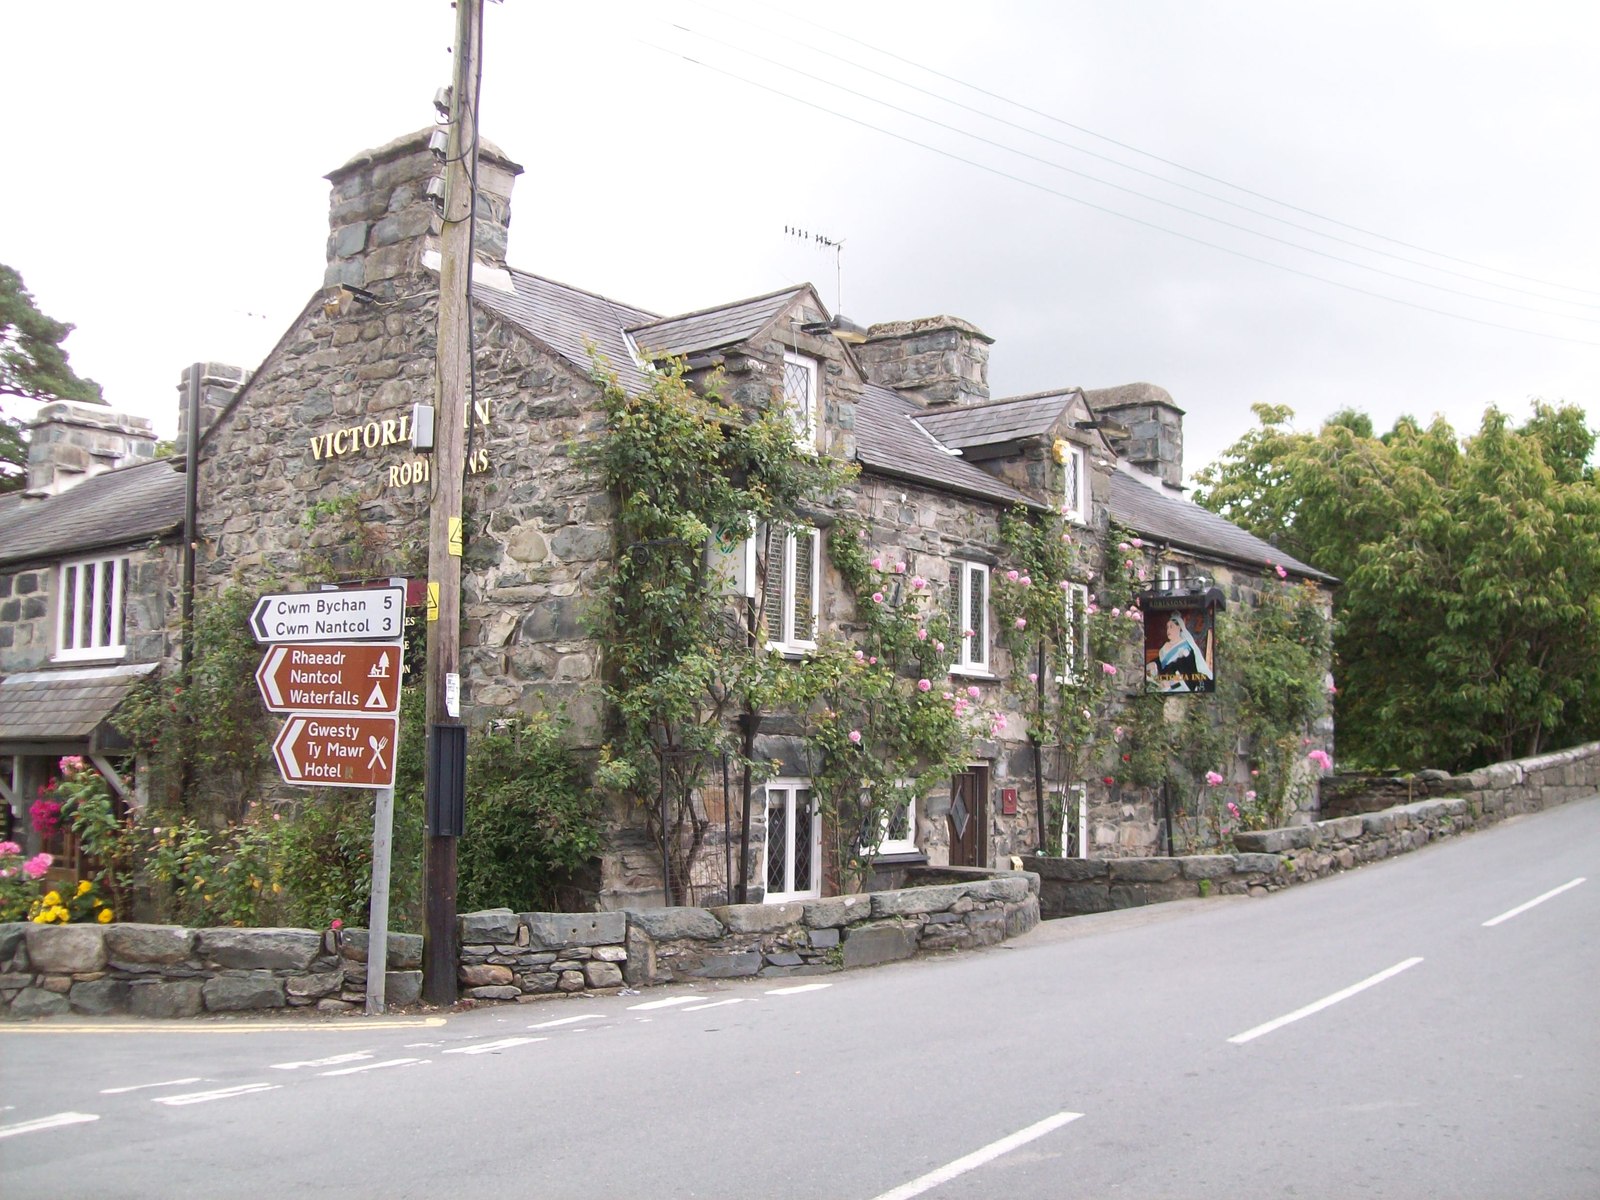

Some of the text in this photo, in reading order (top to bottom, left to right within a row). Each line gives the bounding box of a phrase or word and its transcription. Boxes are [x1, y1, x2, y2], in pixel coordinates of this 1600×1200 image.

[277, 596, 392, 616] Cwm Bychan 5
[275, 622, 309, 636] Cwm
[315, 618, 370, 634] Nantcol
[382, 617, 392, 631] 3
[291, 650, 346, 665] Rhaeadr
[290, 669, 342, 685] Nantcol
[290, 690, 359, 706] Waterfalls
[308, 722, 360, 740] Gwesty
[307, 741, 365, 759] Ty Mawr
[304, 762, 341, 778] Hotel
